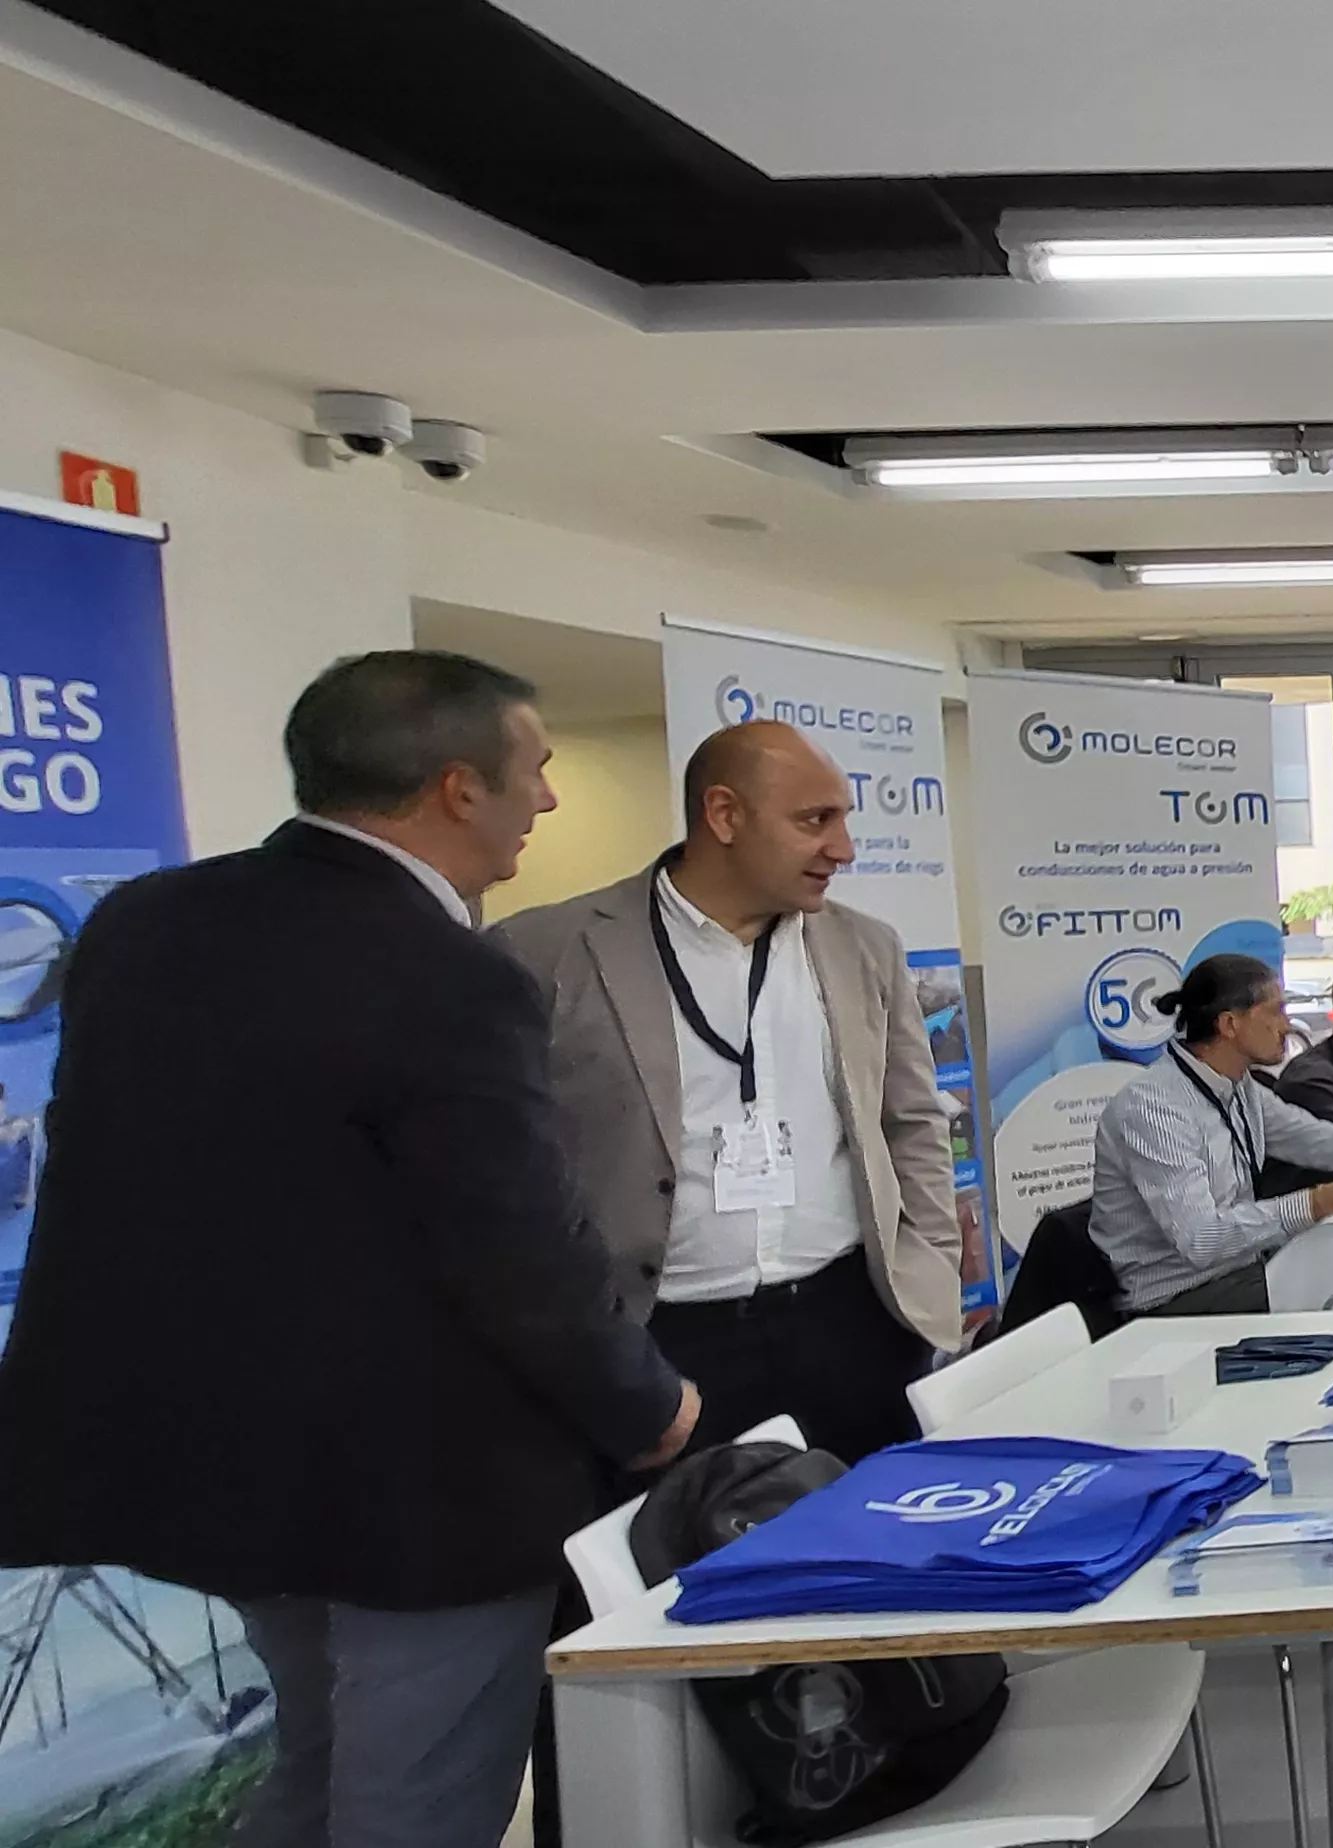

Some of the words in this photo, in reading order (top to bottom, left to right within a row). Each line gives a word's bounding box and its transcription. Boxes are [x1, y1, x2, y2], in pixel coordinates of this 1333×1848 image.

[773, 700, 914, 737] MOLECOR
[1081, 731, 1237, 758] MOLECOR
[1159, 790, 1269, 825] TOM
[1054, 841, 1070, 854] La
[1075, 842, 1120, 856] mejor
[1125, 840, 1186, 854] solución
[1190, 843, 1221, 856] para
[1018, 863, 1124, 877] conducciones
[1129, 861, 1147, 875] de
[1151, 863, 1187, 877] agua
[1190, 864, 1199, 874] a
[1202, 860, 1254, 877] presión
[1037, 907, 1182, 937] FITTOM
